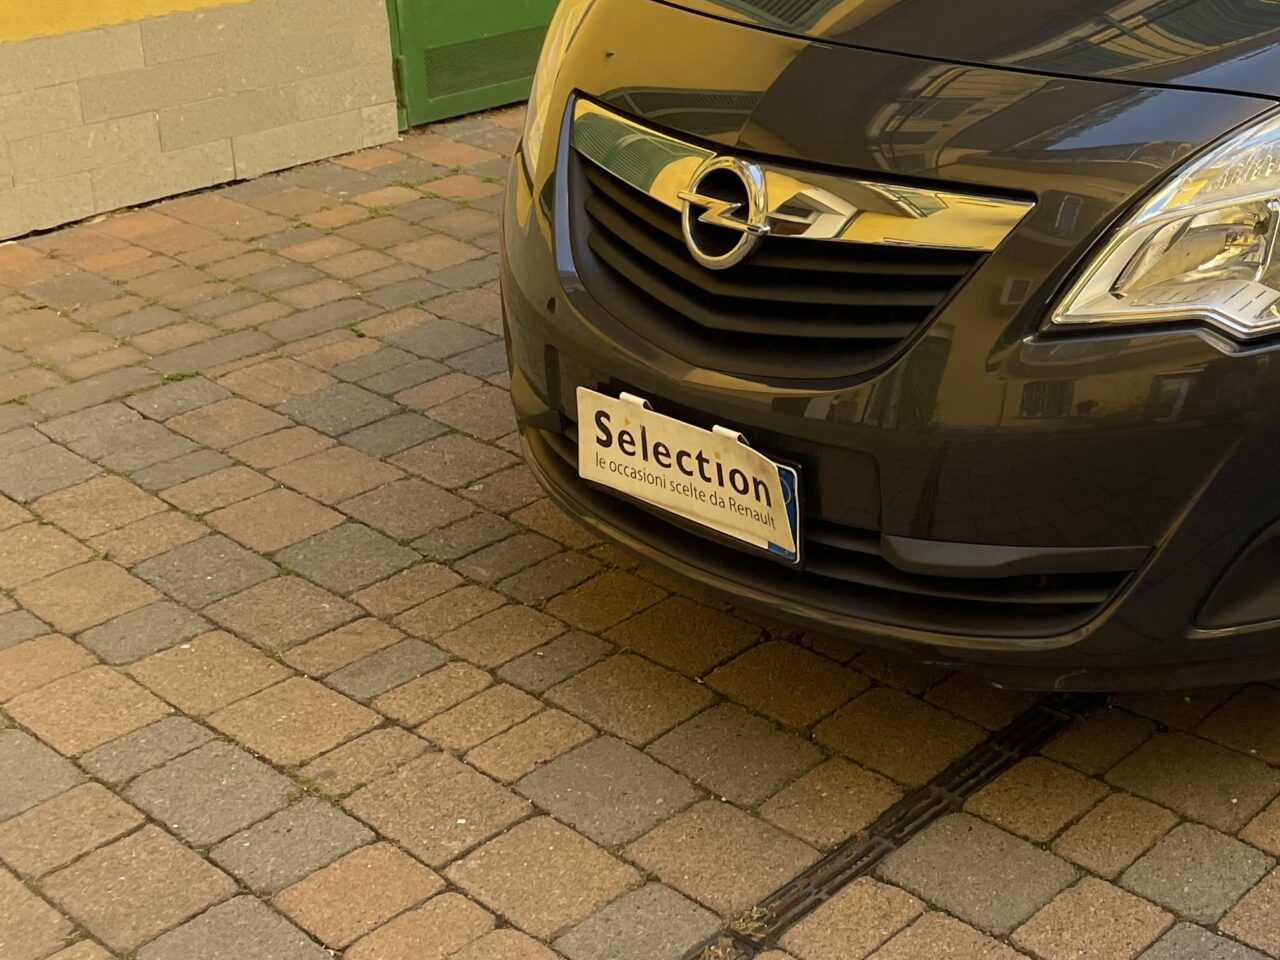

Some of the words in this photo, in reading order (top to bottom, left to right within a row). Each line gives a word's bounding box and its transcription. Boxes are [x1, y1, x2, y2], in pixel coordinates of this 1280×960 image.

[595, 451, 606, 469] le
[609, 460, 667, 489] occasioni
[669, 480, 706, 502] scelte
[709, 491, 726, 509] da
[728, 496, 776, 530] Renault
